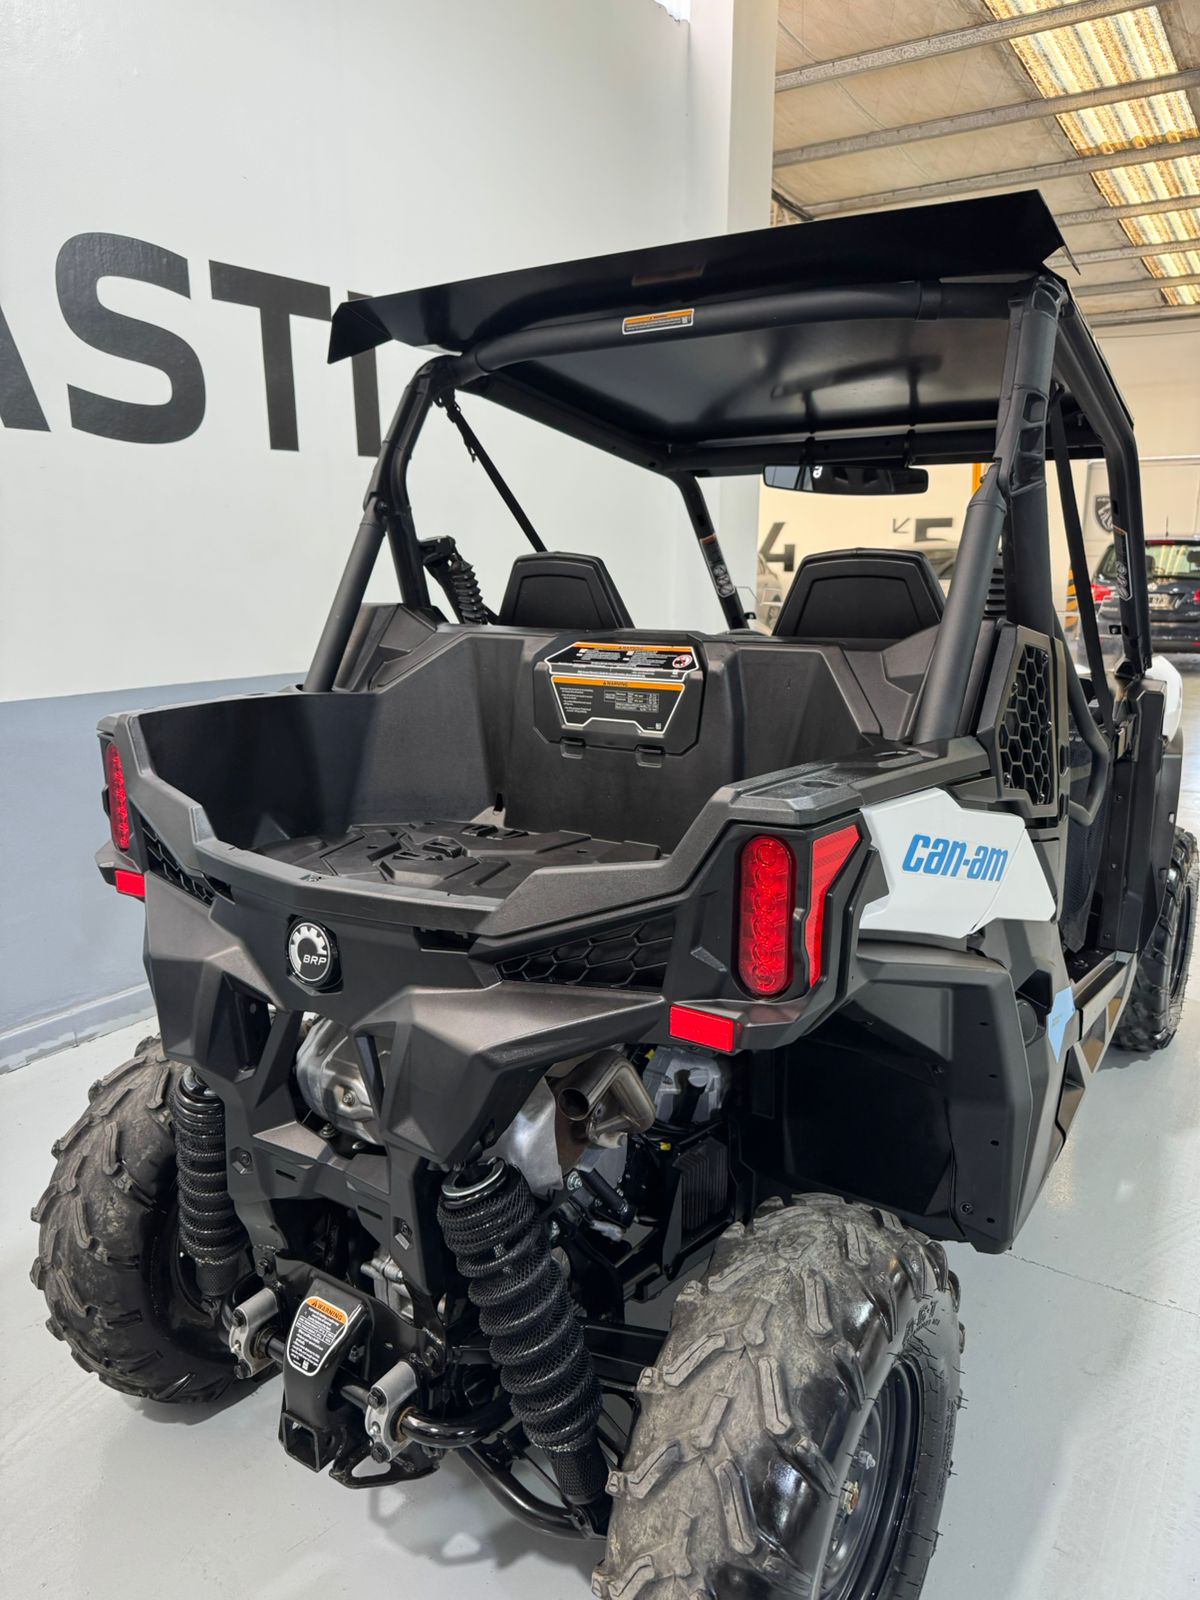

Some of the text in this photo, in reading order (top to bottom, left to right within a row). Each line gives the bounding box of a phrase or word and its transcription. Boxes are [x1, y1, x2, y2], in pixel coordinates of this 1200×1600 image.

[759, 522, 795, 572] 4
[303, 954, 327, 966] BRP
[317, 1304, 343, 1321] WARNING
